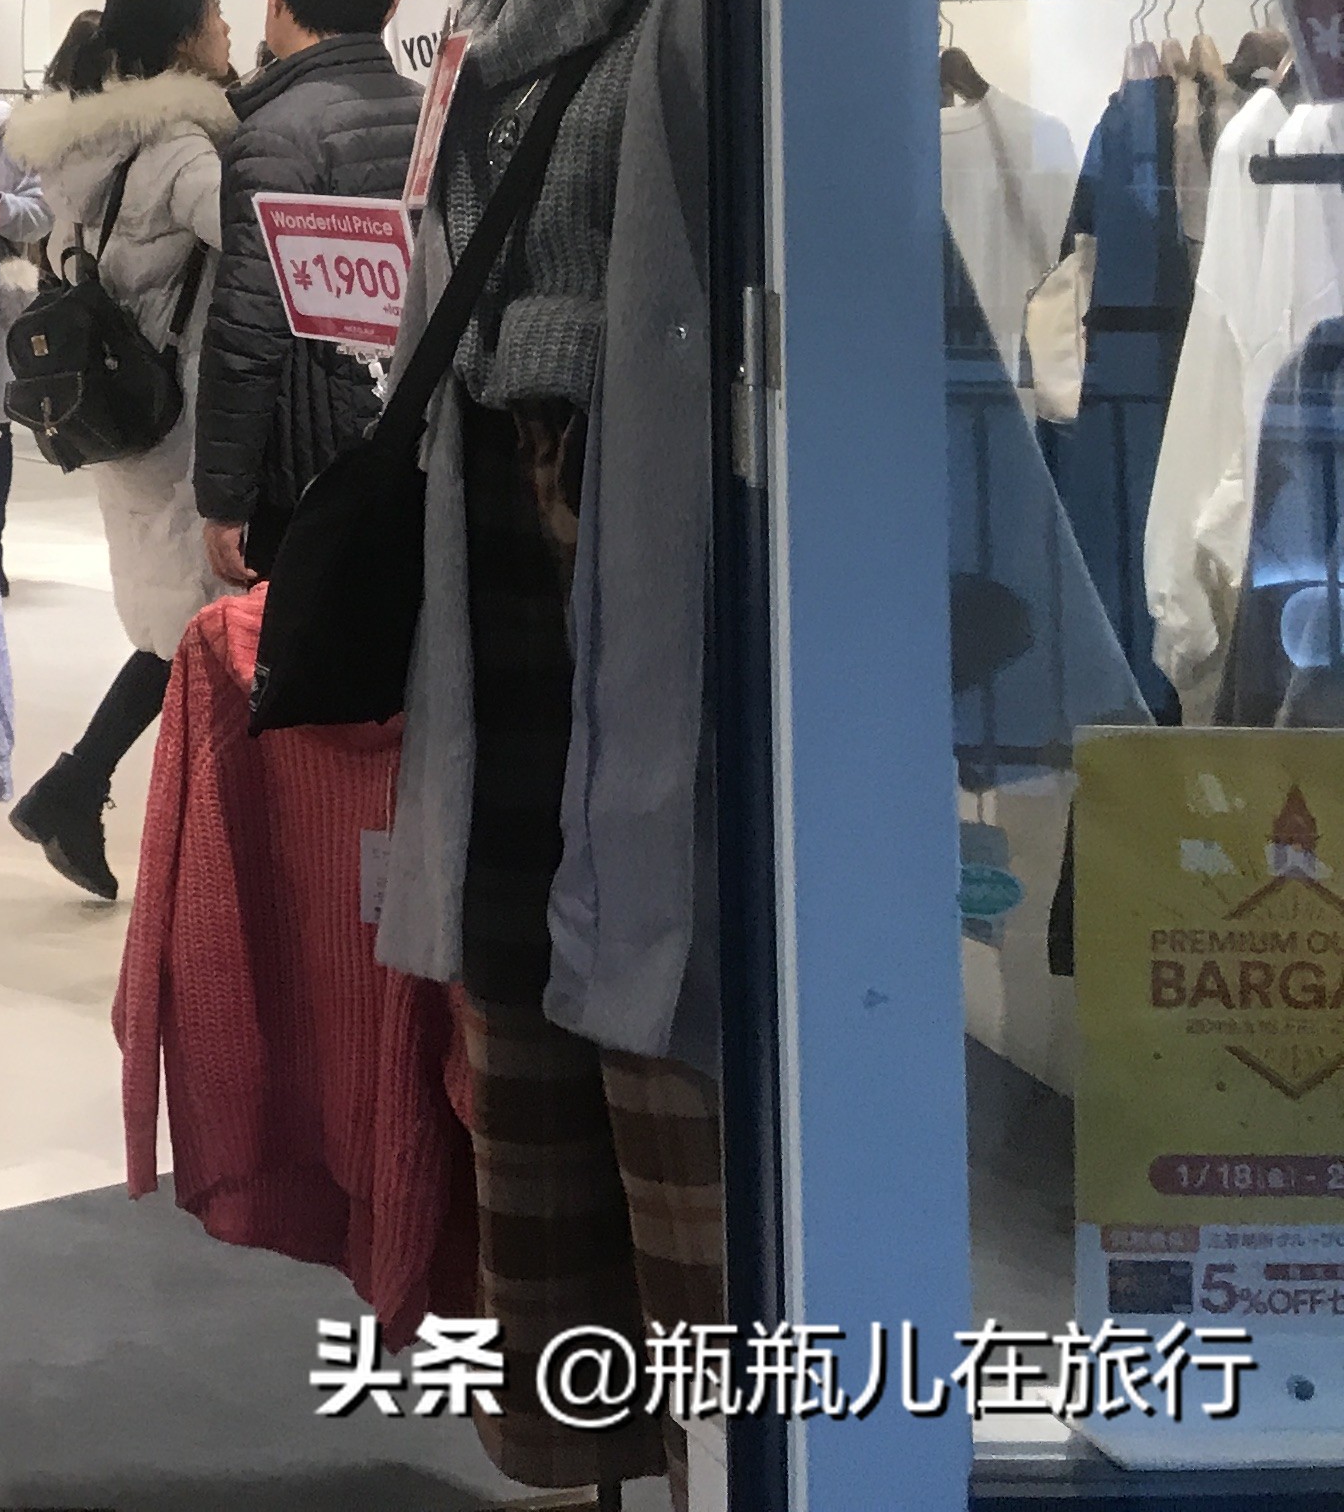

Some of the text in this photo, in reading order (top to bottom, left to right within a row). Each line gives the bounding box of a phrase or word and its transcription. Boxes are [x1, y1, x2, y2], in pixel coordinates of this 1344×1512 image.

[270, 210, 394, 236] Wonderful Price
[289, 253, 401, 300] ¥1,900
[1151, 929, 1298, 954] PREMIUM
